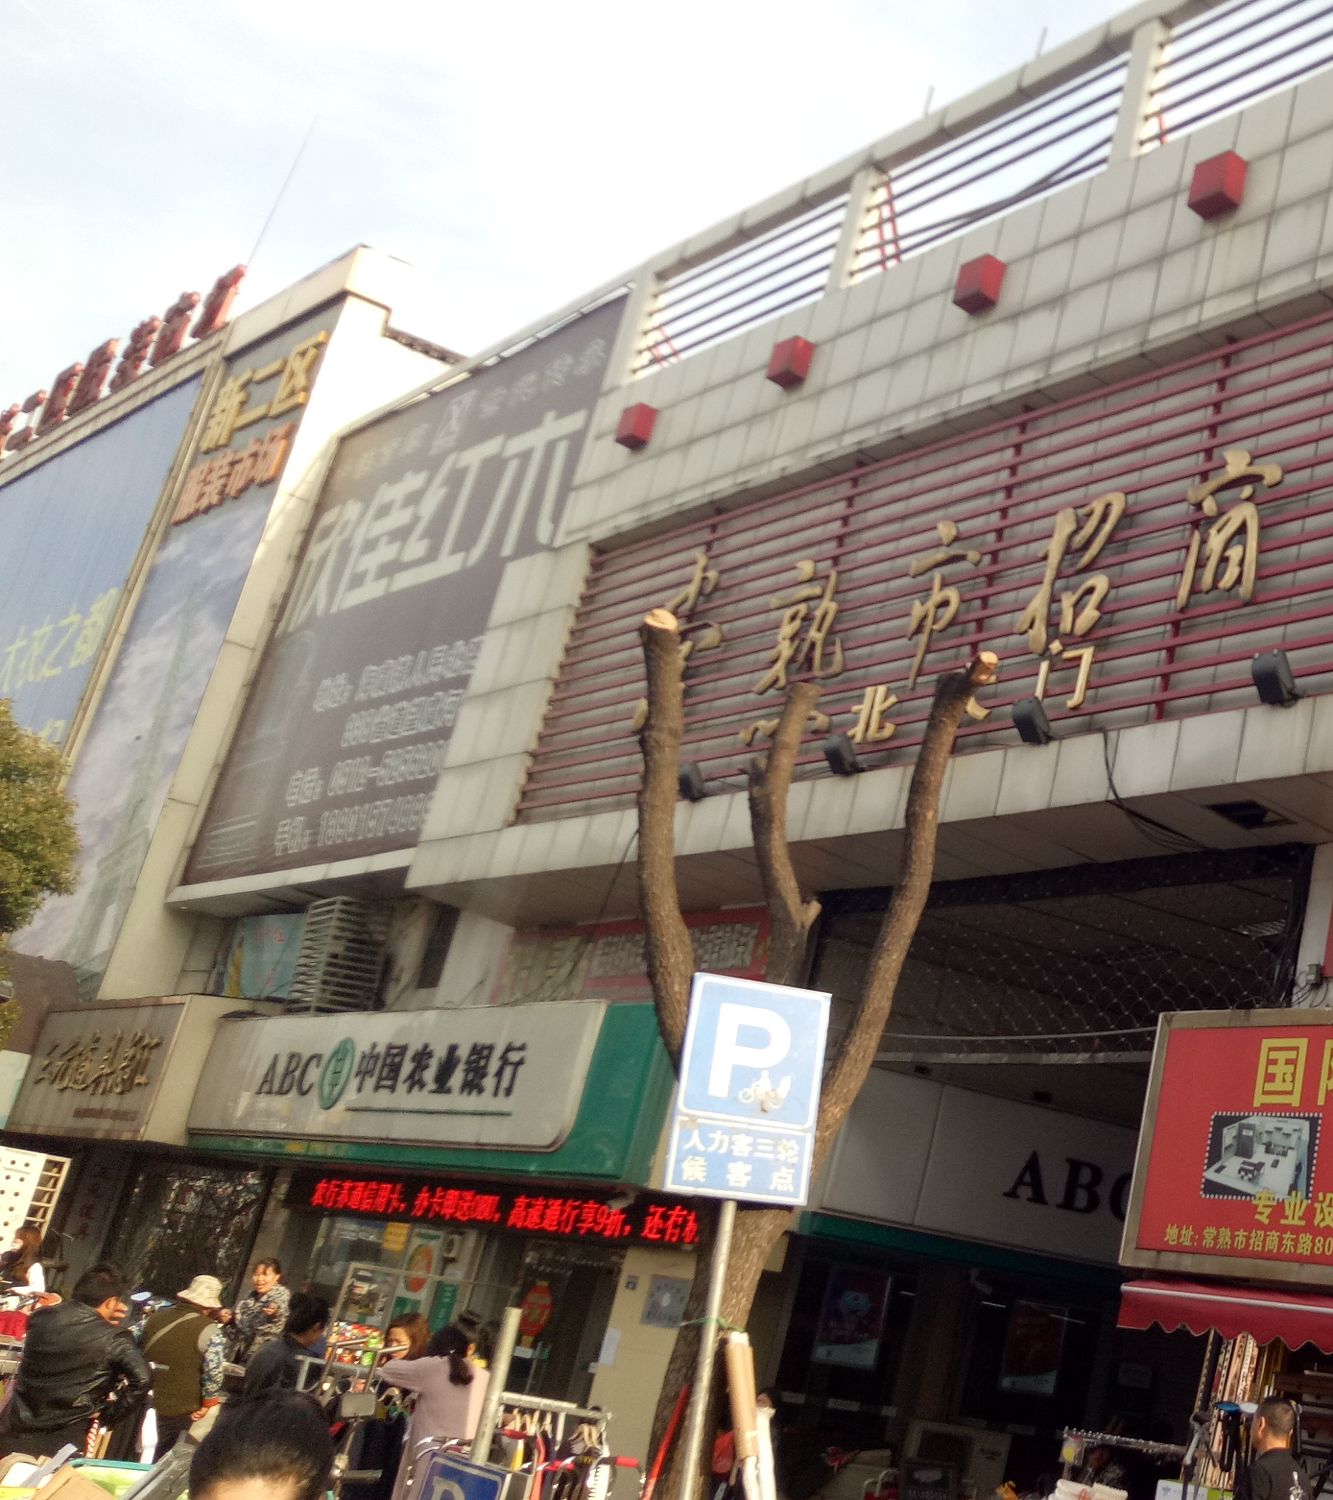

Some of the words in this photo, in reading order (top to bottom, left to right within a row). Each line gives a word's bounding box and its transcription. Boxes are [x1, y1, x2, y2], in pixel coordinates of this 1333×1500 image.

[254, 1051, 324, 1097] ABC
[353, 1040, 529, 1099] 中国农业银行
[707, 1002, 792, 1099] P
[682, 1127, 801, 1164] 人力客三轮
